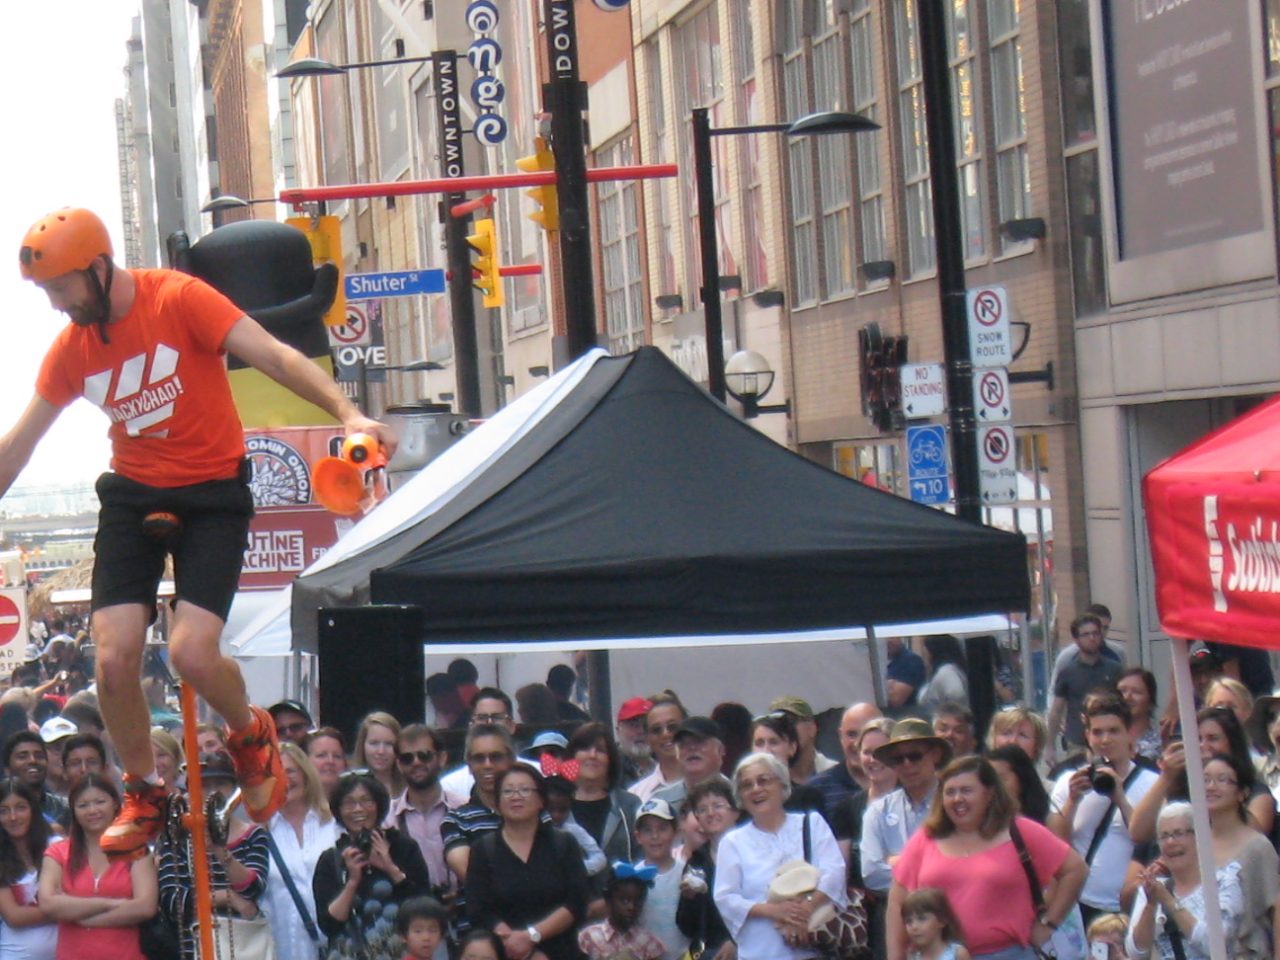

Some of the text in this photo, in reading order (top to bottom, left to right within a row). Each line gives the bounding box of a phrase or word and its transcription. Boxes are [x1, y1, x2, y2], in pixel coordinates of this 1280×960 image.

[439, 60, 461, 178] OWNTOWN
[350, 275, 407, 294] Shuter
[977, 332, 1003, 344] SNOW
[338, 346, 386, 366] OVE
[976, 346, 1006, 357] ROUTE
[915, 366, 929, 381] NO
[904, 382, 943, 397] STANDING
[287, 455, 308, 502] ONION
[928, 479, 943, 495] 10
